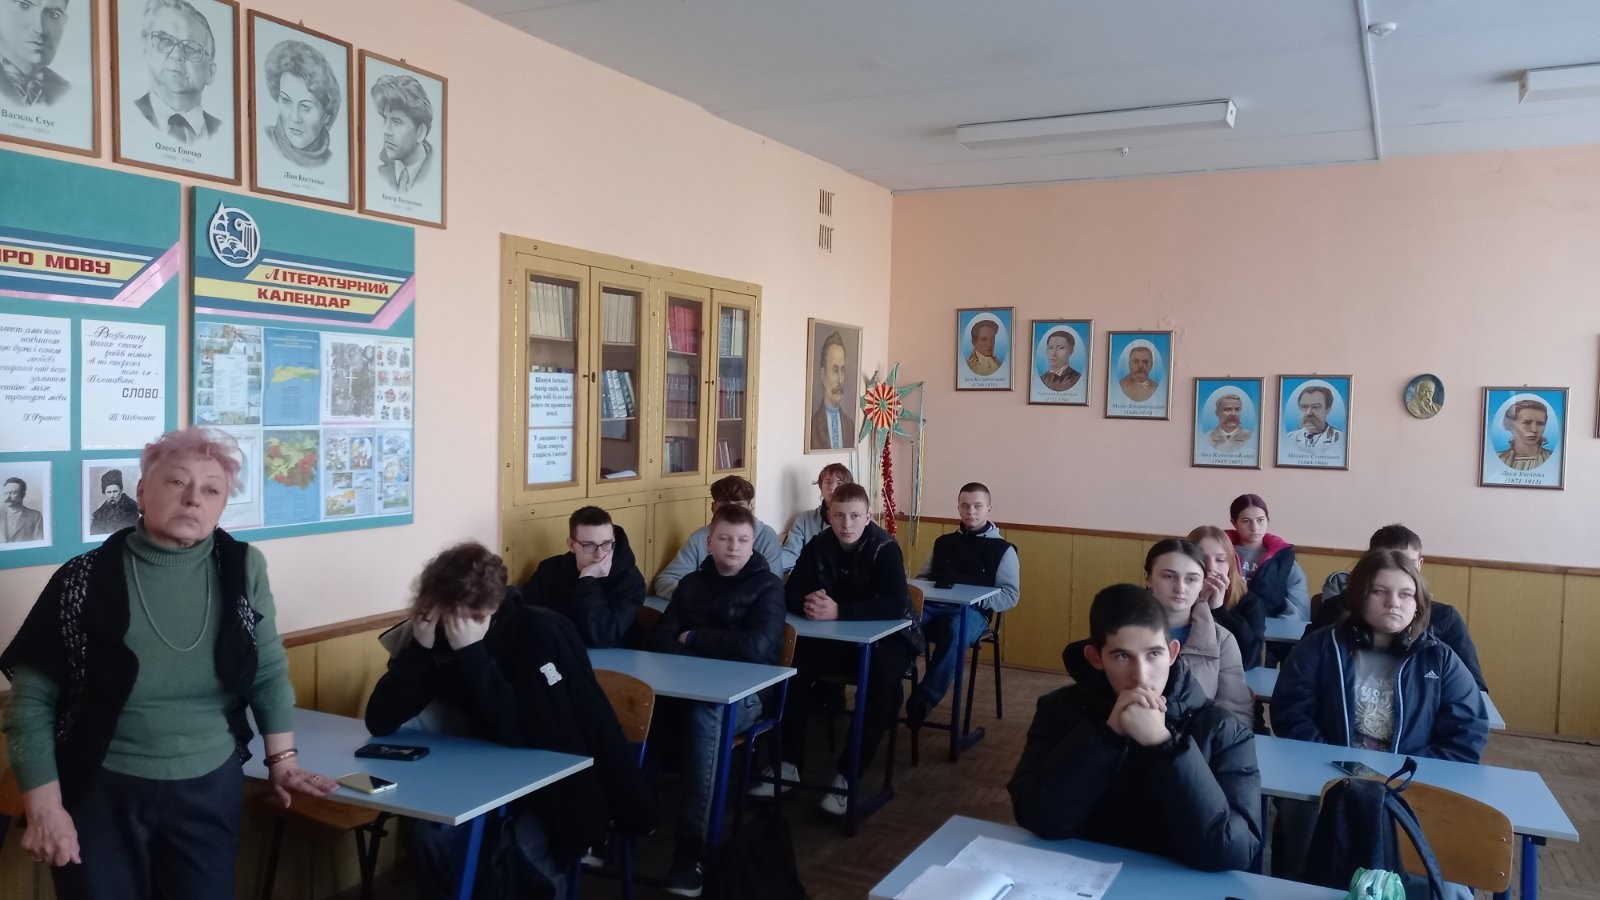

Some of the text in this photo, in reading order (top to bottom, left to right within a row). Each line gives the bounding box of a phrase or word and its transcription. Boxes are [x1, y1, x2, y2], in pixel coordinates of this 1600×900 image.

[1, 108, 34, 123] Василь
[36, 116, 56, 128] Стус
[155, 142, 202, 158] Олесь Гончар
[0, 248, 111, 275] РО МОВУ
[265, 268, 389, 295] ЛІТЕРАТУРНИЙ
[257, 287, 350, 309] КАЛЕНДАР
[122, 387, 159, 399] СЛОВО
